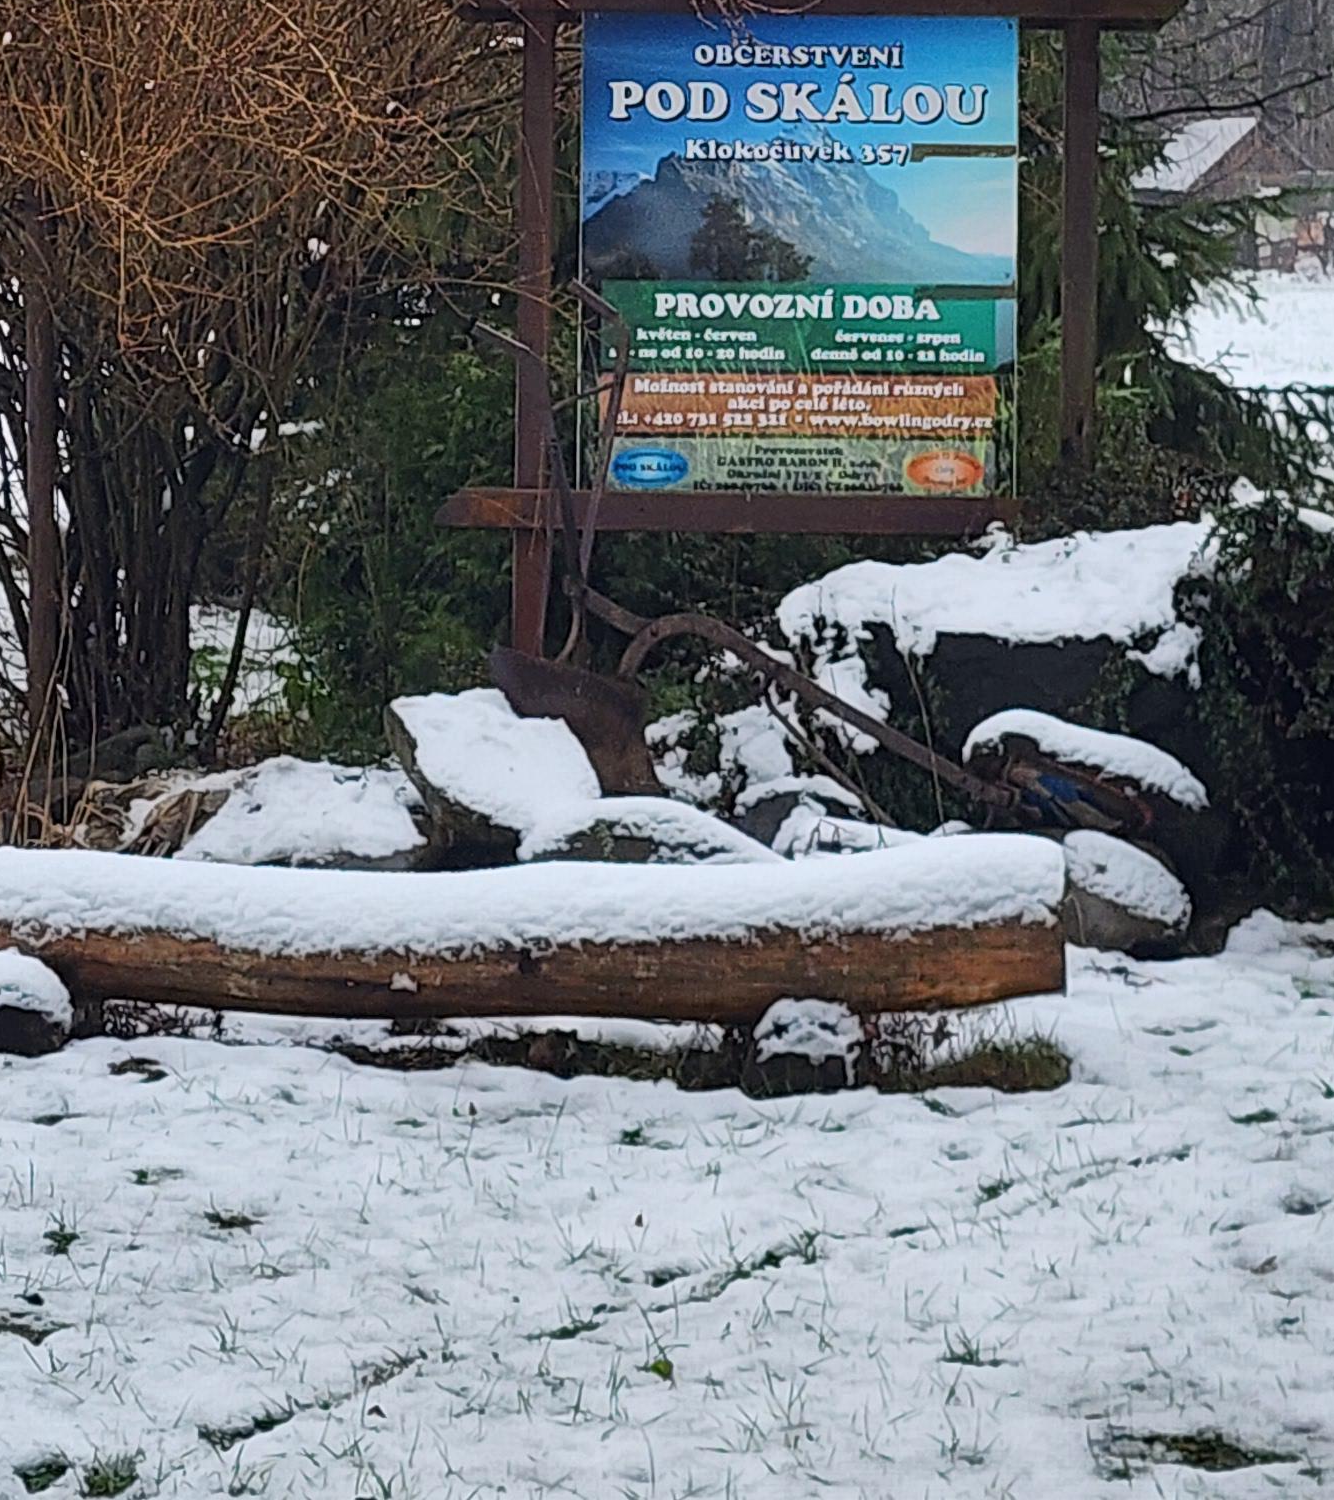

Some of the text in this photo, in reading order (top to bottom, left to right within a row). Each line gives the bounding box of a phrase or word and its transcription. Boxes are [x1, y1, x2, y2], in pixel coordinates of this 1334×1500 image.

[694, 38, 903, 67] OBČERSTVENÍ
[608, 73, 989, 125] POD SKÁLOU
[859, 143, 909, 166] 357
[654, 289, 940, 321] PROVOZNÍ DOBA
[636, 327, 692, 341] květen
[703, 327, 757, 342] červen
[834, 329, 905, 344] červenec
[916, 332, 961, 345] srpen
[661, 346, 681, 359] od
[685, 346, 704, 359] 10
[739, 346, 785, 360] hodin
[810, 347, 858, 361] denně
[861, 348, 881, 361] od
[885, 349, 905, 361] 10
[939, 348, 985, 362] hodin
[634, 377, 964, 398] Možnost stanování a pořádání různých
[727, 396, 766, 410] akcí
[769, 398, 791, 412] po
[793, 396, 828, 411] celé
[643, 411, 684, 426] +420
[809, 413, 993, 430] www.bowlingodry.cz
